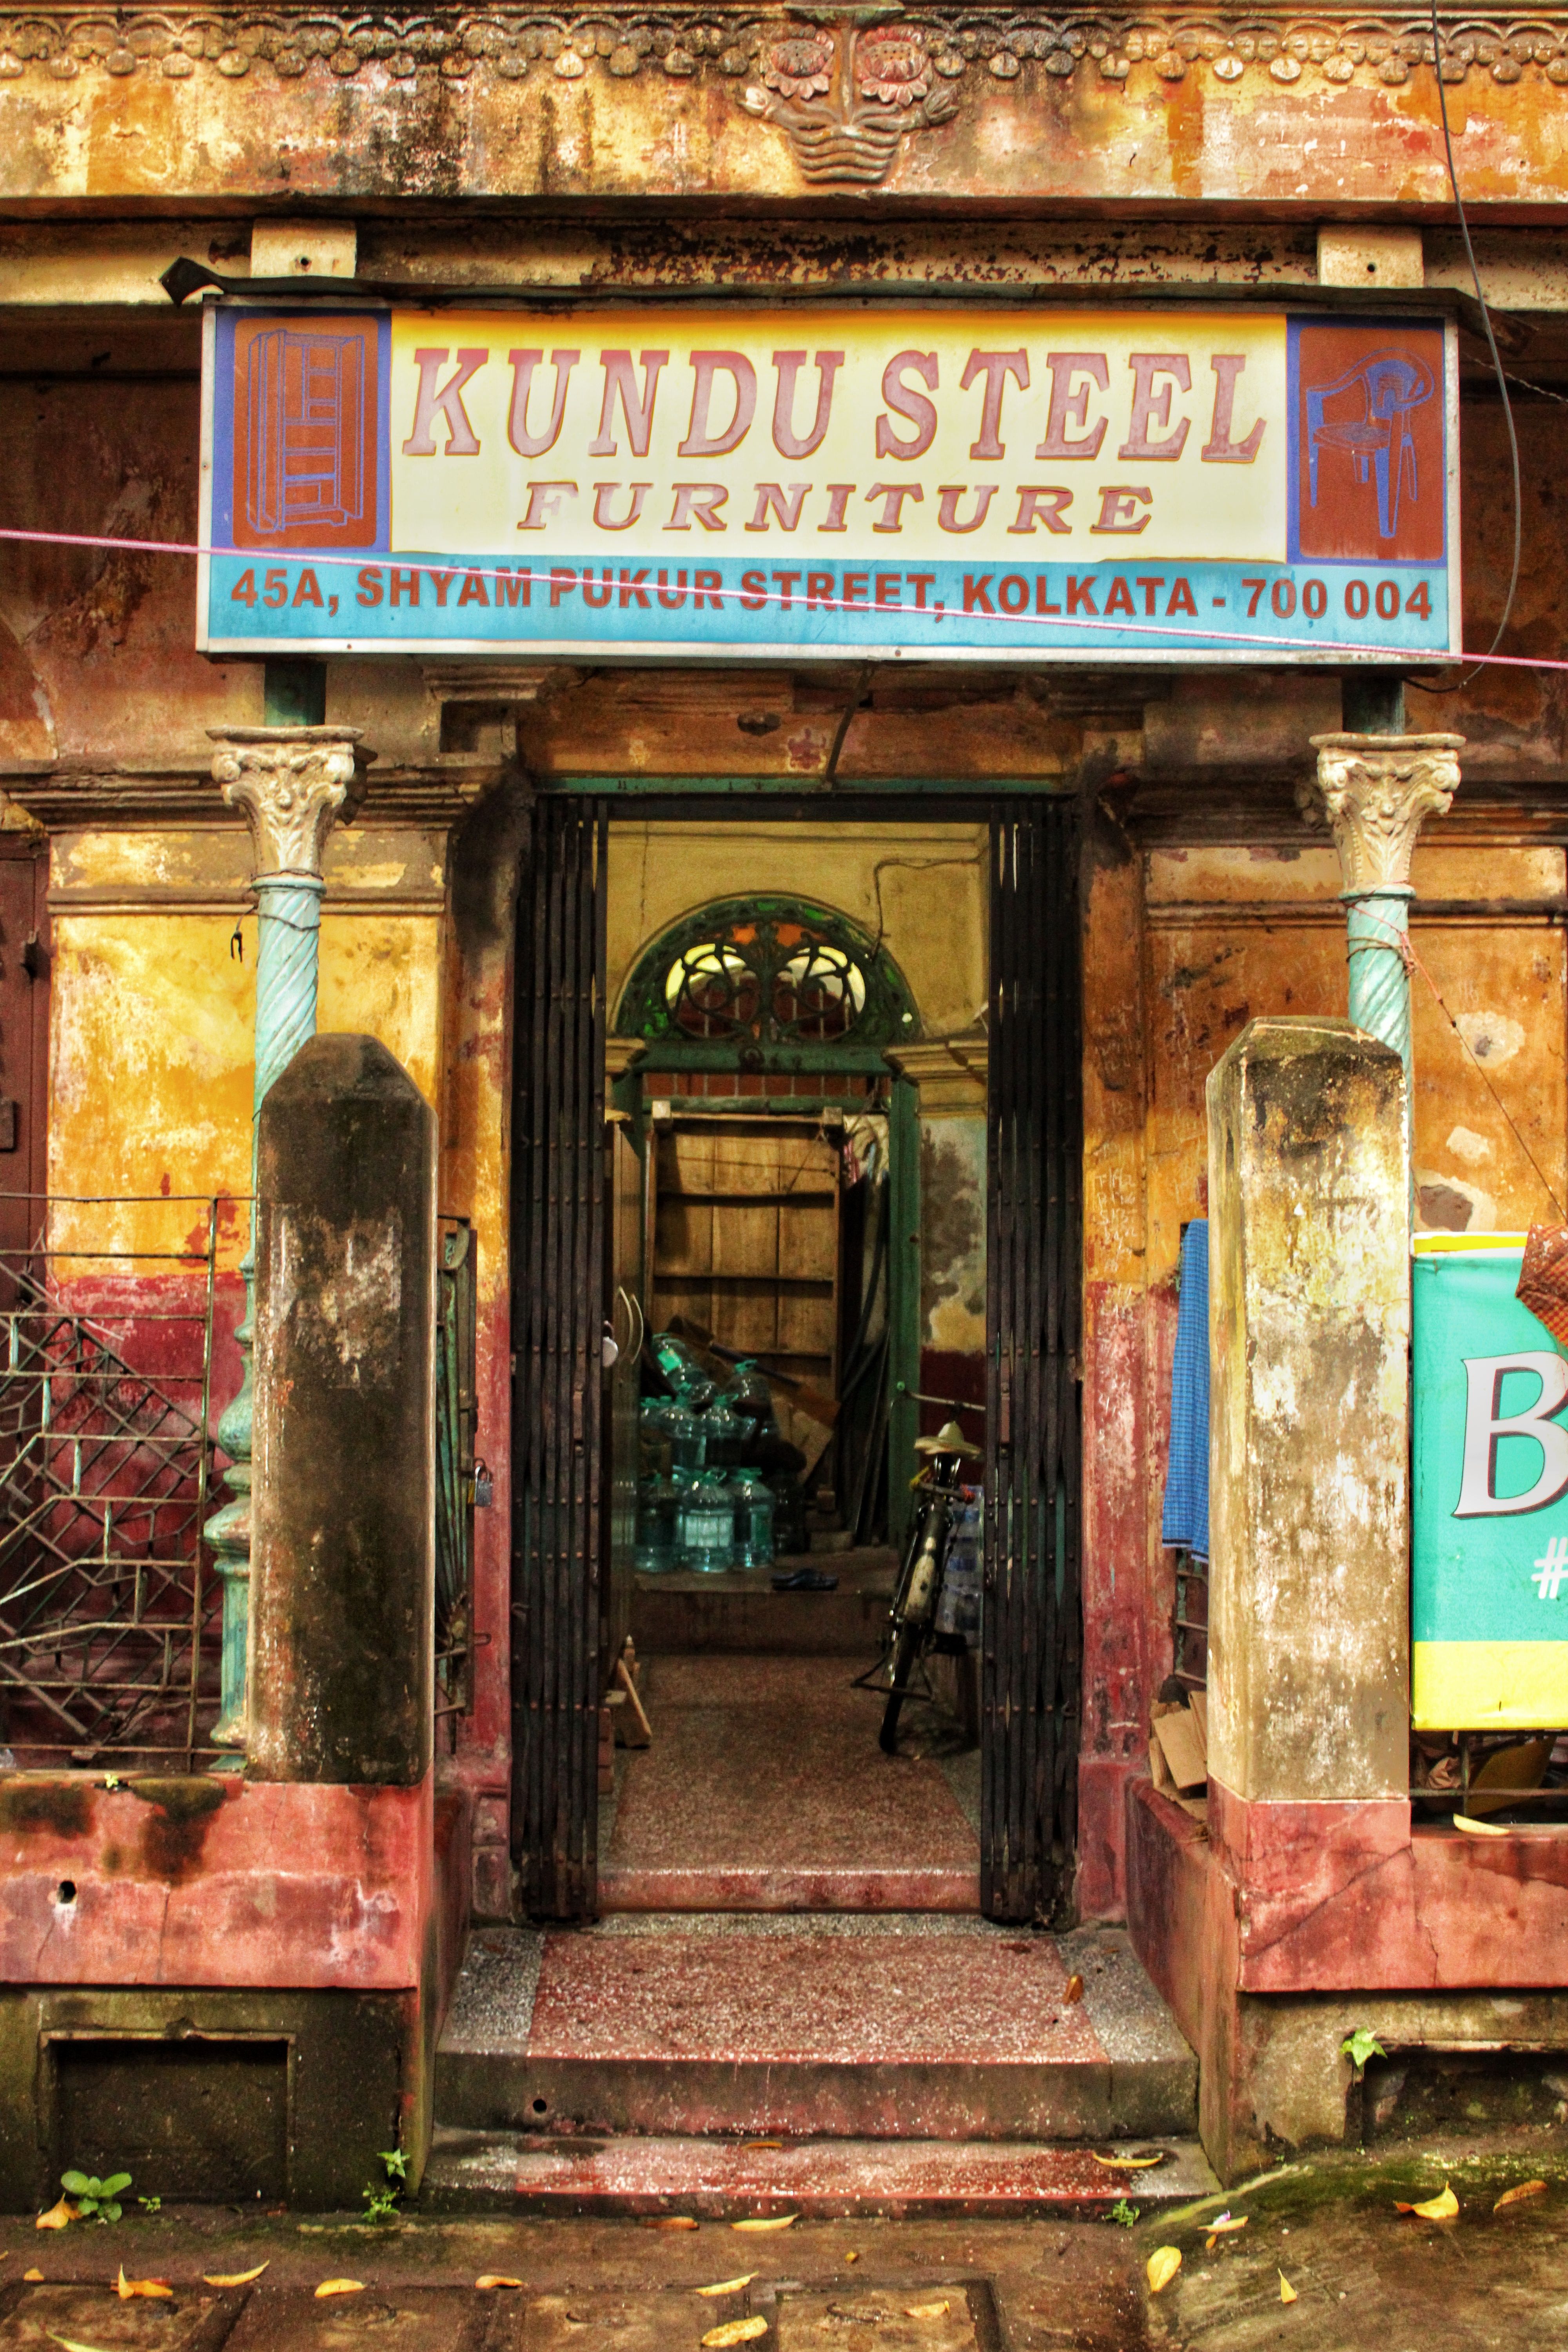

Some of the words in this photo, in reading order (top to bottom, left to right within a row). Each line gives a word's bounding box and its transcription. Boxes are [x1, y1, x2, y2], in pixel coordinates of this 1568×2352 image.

[401, 348, 845, 460] KUNDU
[875, 348, 1267, 464] STEEL
[517, 481, 1153, 534] FURNITURE
[230, 568, 339, 617] 45A,
[356, 567, 534, 608] SHYAM
[550, 568, 724, 611] PUKUR
[739, 571, 946, 624] STREET,
[963, 575, 1198, 617] KOLKATA
[1242, 578, 1328, 619] 700
[1344, 580, 1432, 621] 004
